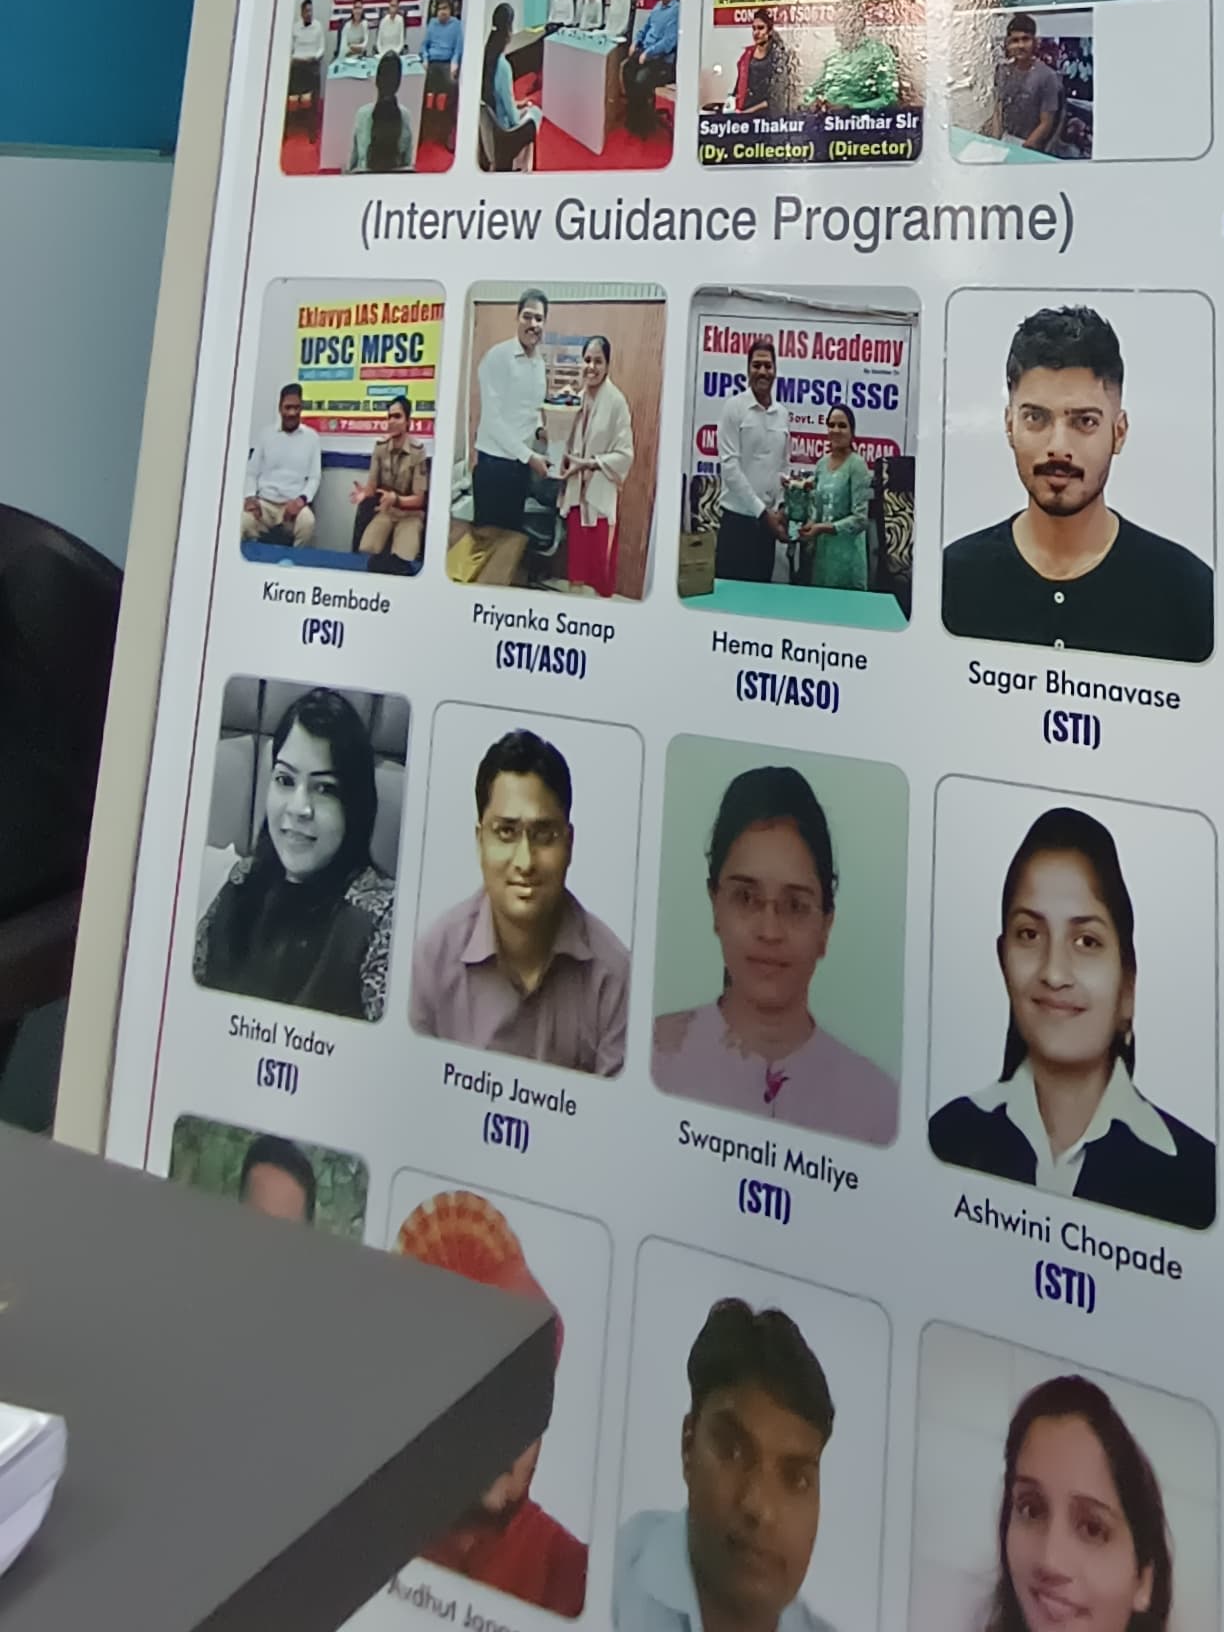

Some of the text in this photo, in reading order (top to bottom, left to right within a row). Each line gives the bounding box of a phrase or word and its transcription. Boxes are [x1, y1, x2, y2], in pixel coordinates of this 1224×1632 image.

[700, 118, 805, 138] Saylee Thakur
[824, 113, 919, 131] Shridhar Sir
[699, 141, 815, 162] (Dy. Collector)
[829, 139, 913, 160] (Director)
[360, 191, 1076, 254] (Interview Guidance Programme)
[299, 303, 378, 329] Eklavya IAS
[300, 331, 425, 366] UPSC MPSC
[778, 329, 904, 368] IAS Academy
[775, 376, 899, 410] MPSC SSC
[262, 582, 391, 614] Kiran Bembade
[301, 617, 345, 649] (PSI)
[472, 603, 616, 642] Priyanka Sanap
[495, 640, 587, 680] (STI/ASO)
[711, 631, 868, 672] Hema Ranjane
[735, 670, 841, 714] (STI/ASO)
[967, 661, 1182, 710] Sagar Bhanavase
[1041, 708, 1101, 751] (STI)
[228, 1014, 336, 1058] Shital Yadav
[256, 1057, 299, 1096] (STI)
[442, 1063, 577, 1117] Pradip Jawale
[482, 1112, 530, 1154] (STI)
[677, 1119, 860, 1192] Swapnali Maliye
[738, 1177, 792, 1226] (STI)
[954, 1193, 1184, 1281] Ashwini Chopade
[1034, 1259, 1096, 1315] (STI)
